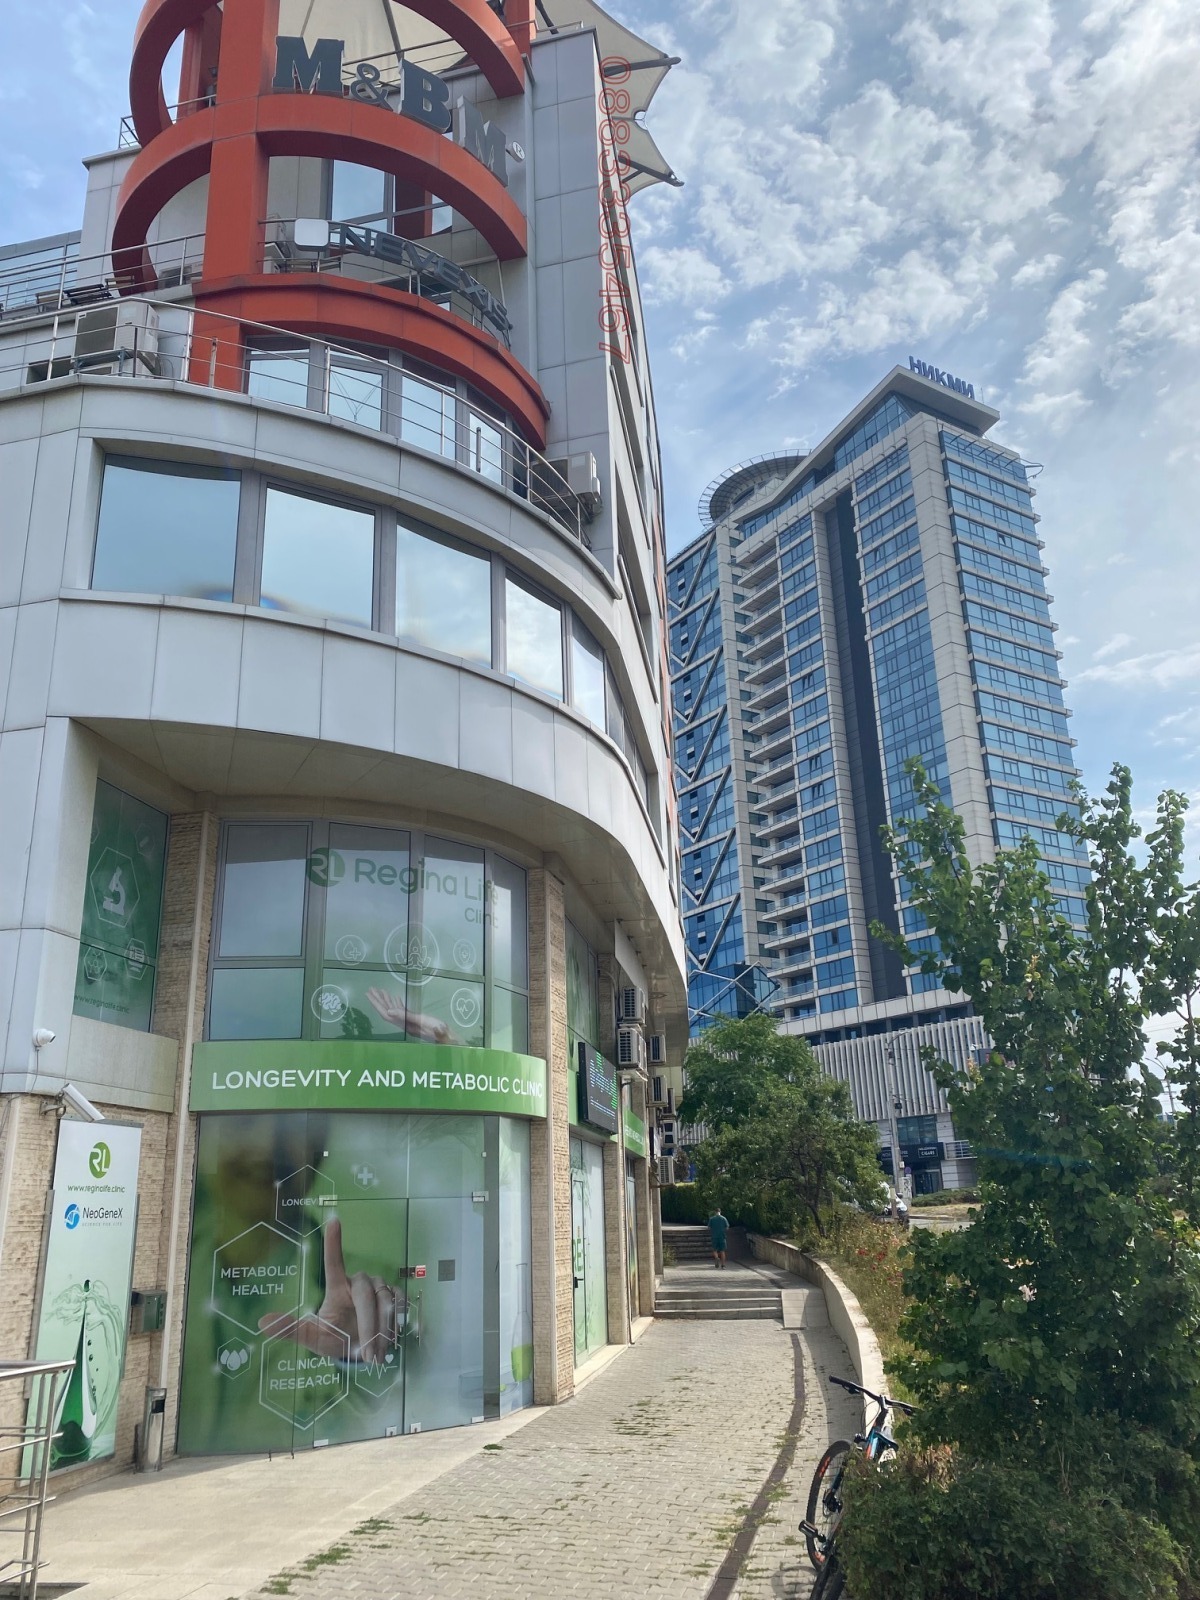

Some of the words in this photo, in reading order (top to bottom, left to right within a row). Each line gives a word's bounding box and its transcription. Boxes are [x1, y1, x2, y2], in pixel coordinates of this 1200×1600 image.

[598, 56, 632, 364] 0883335467
[908, 355, 976, 400] НИКМИ
[354, 858, 458, 895] Regina
[212, 1069, 351, 1090] LONGEVITY
[357, 1069, 405, 1088] AND
[412, 1070, 510, 1093] METABOLIC
[512, 1078, 544, 1098] CLINIC
[82, 1207, 124, 1219] NeoGeneX
[220, 1265, 298, 1279] METABOLIC
[232, 1283, 284, 1296] HEALTH
[277, 1356, 335, 1371] CLNICAL
[269, 1373, 340, 1391] RESEARCH
